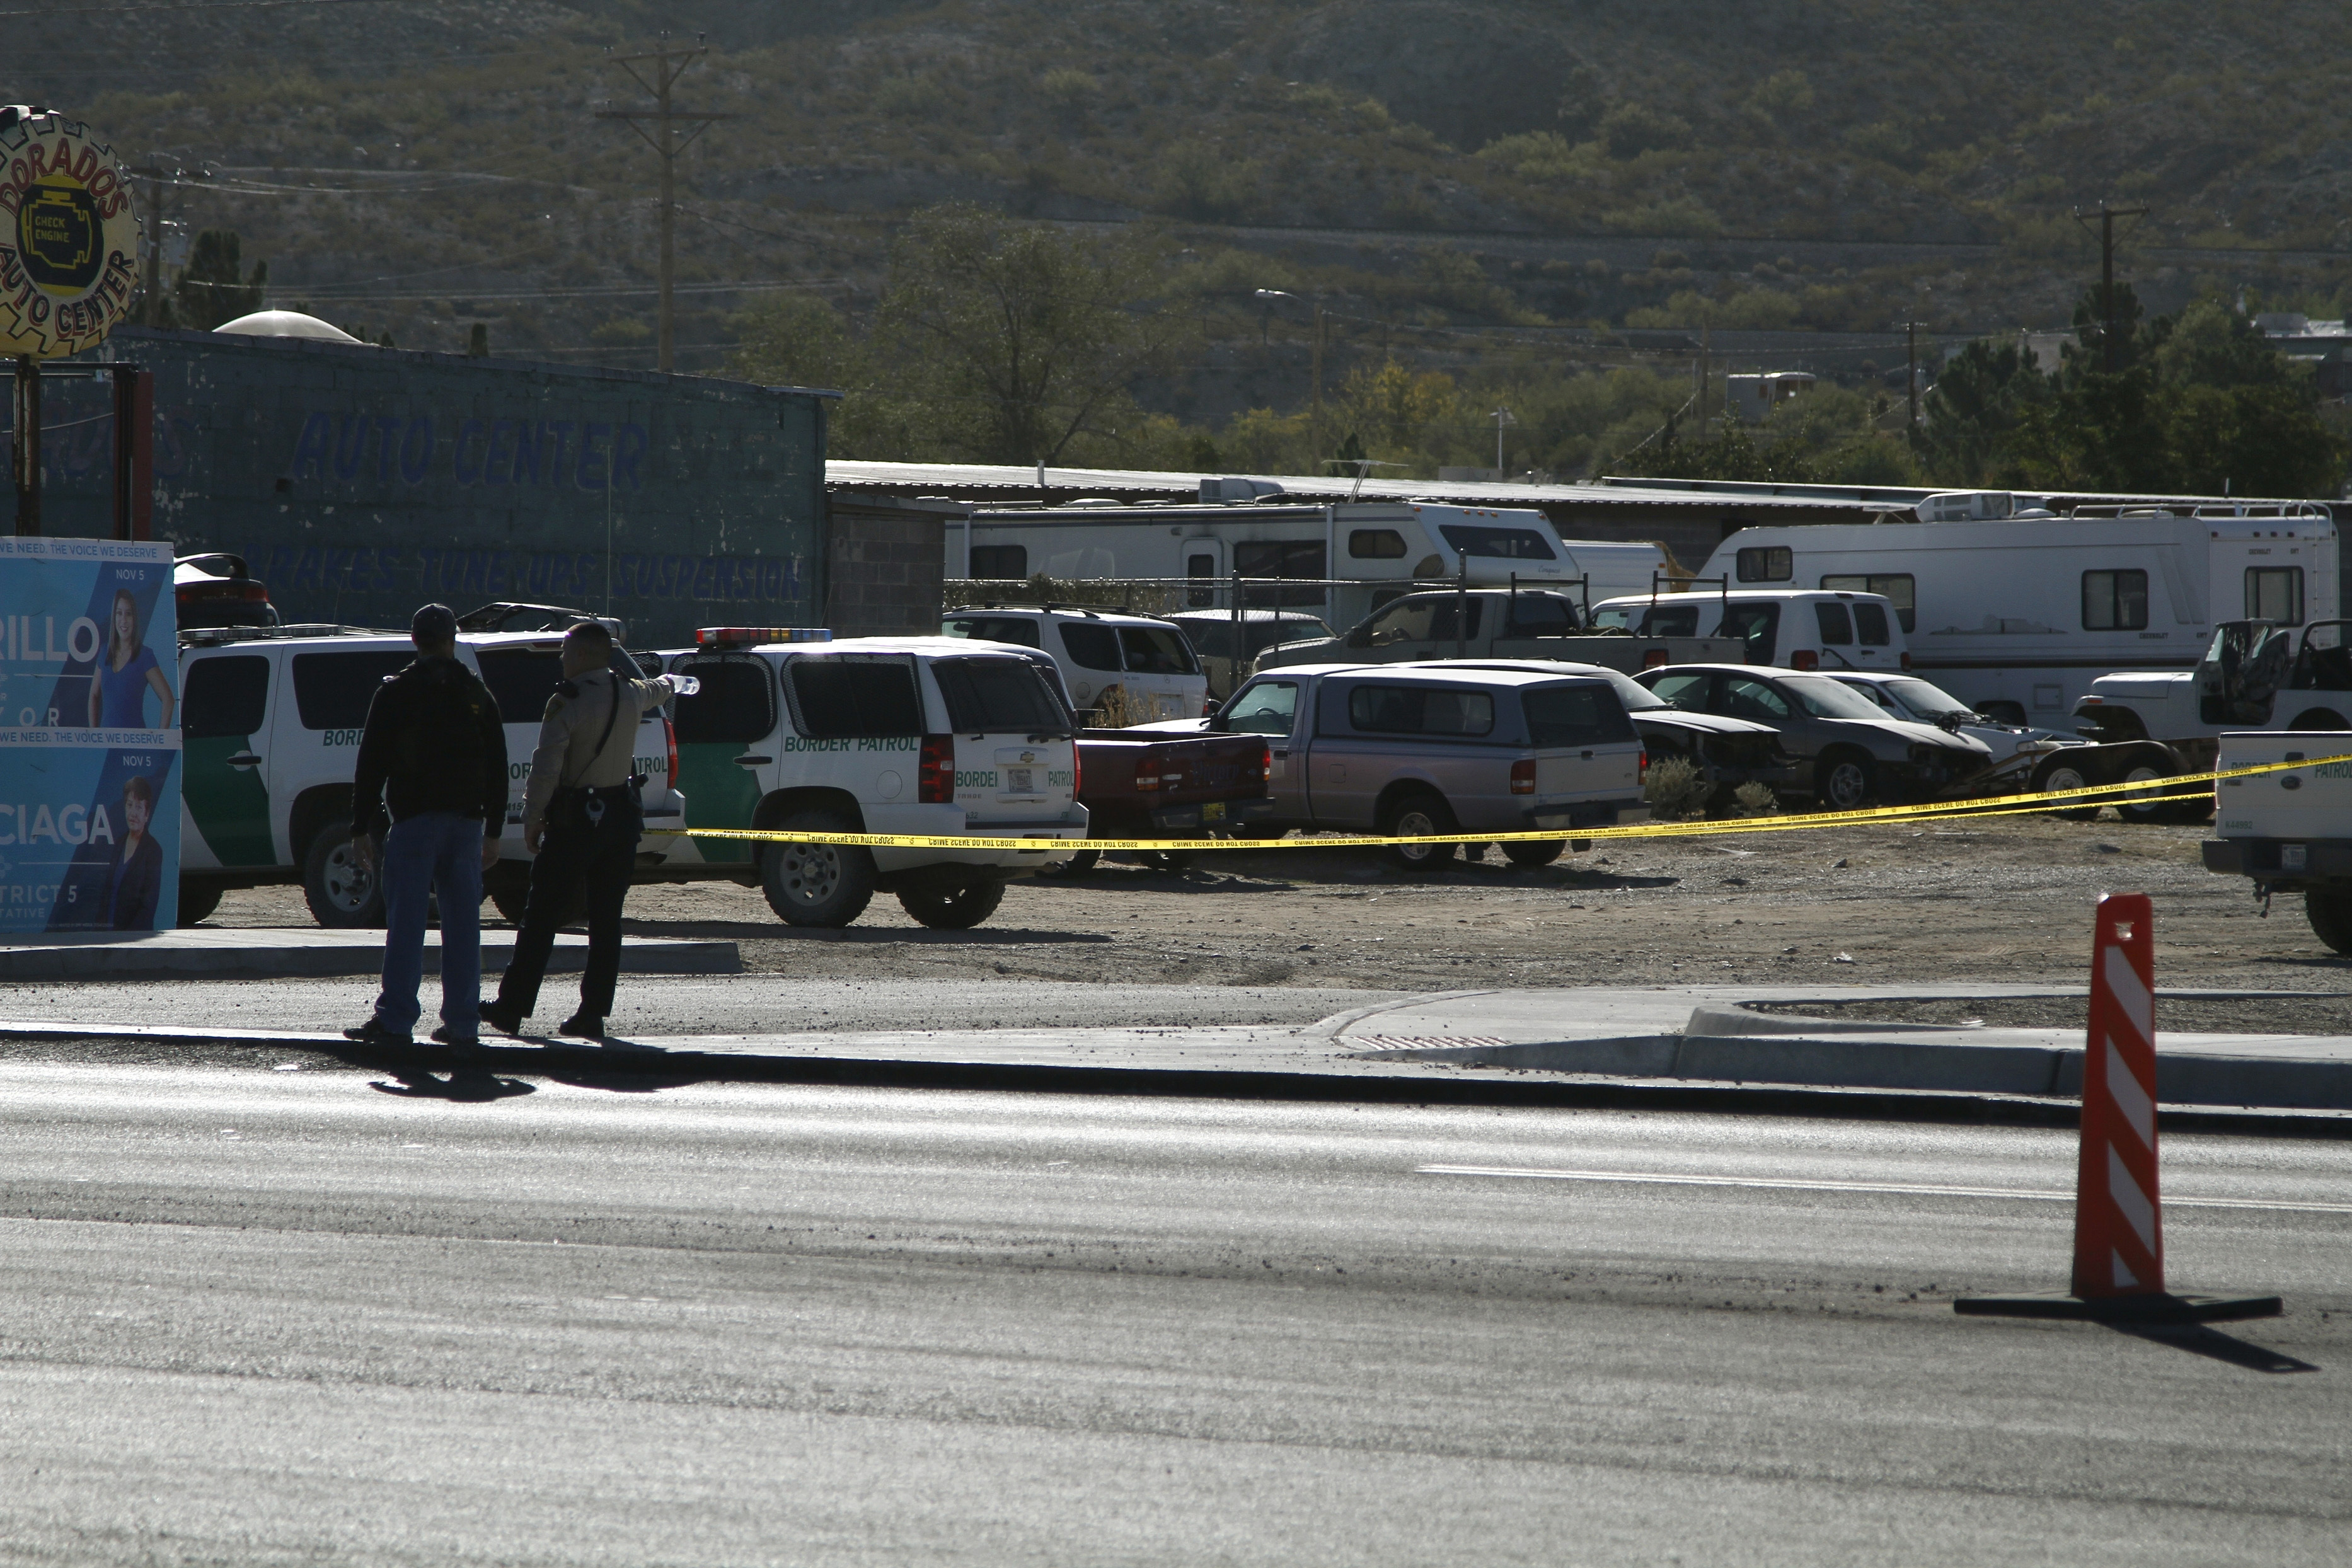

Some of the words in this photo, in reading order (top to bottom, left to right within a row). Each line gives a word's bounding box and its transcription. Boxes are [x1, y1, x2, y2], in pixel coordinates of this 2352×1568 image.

[35, 216, 66, 228] CHECK
[35, 229, 71, 243] ENGINE
[0, 243, 50, 326] AUTO
[55, 250, 134, 338] CENTER
[291, 412, 435, 486] AUTO
[453, 417, 648, 492] CENTER
[17, 543, 47, 553] NEED.
[50, 544, 67, 554] THE
[69, 545, 97, 555] VOICE
[100, 546, 115, 556] WE
[117, 547, 157, 558] DESERVE
[116, 569, 136, 580] NOV
[139, 570, 144, 580] 5
[242, 544, 402, 592] BRAKES
[612, 553, 802, 601] SUSPENSION
[0, 615, 100, 662] ILLO
[0, 732, 16, 742] WE
[21, 732, 51, 742] NEED.
[54, 732, 72, 742] THE
[75, 733, 103, 743] VOICE
[105, 734, 121, 743] WE
[123, 734, 164, 744] DESERVE
[785, 736, 851, 752] BORDER
[858, 736, 918, 751] PATROL
[123, 756, 143, 766] NOV
[146, 756, 151, 766] 5
[1048, 770, 1074, 787] PATROL
[67, 885, 77, 903] 5
